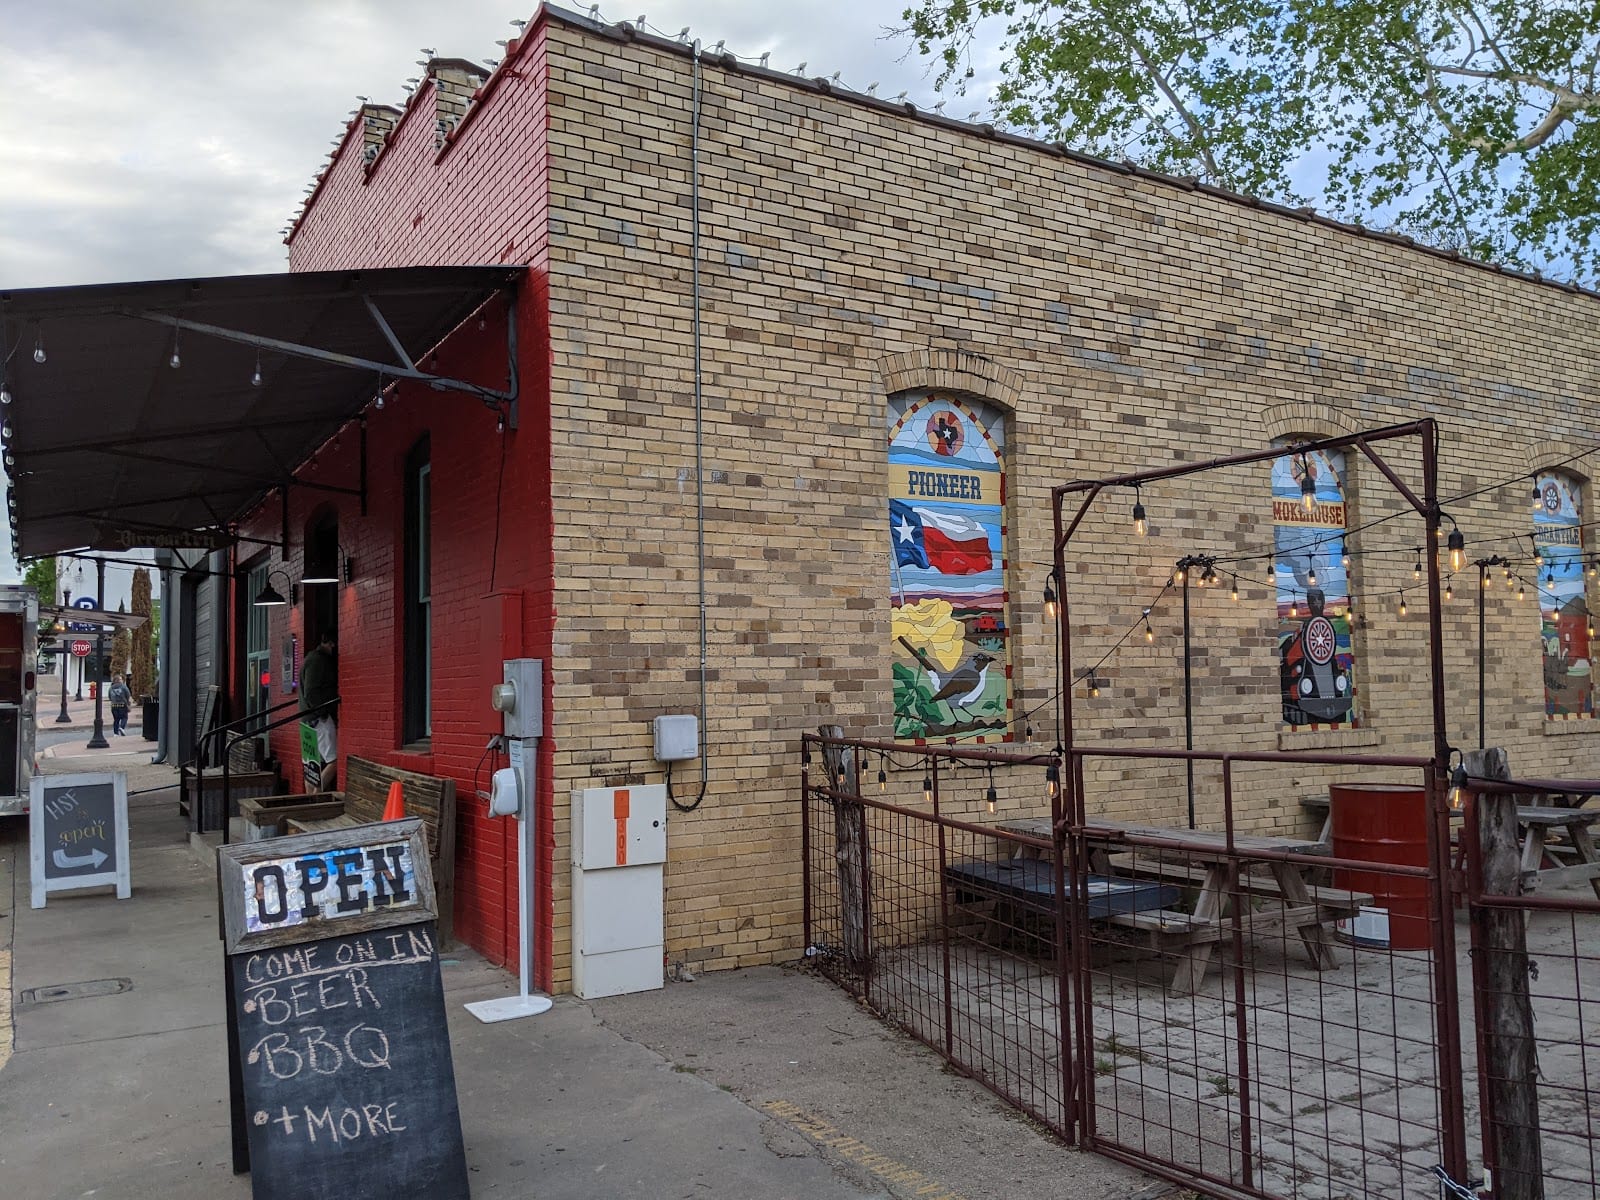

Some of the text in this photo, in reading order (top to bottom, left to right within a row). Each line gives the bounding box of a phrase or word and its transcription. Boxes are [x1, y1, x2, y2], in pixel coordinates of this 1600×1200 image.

[908, 470, 982, 500] PIONEER
[73, 644, 90, 652] STOP
[45, 788, 80, 820] HSF
[60, 824, 105, 844] open
[252, 845, 410, 924] OPEN
[246, 928, 434, 985] COME ON IN
[255, 967, 382, 1026] BEER
[255, 1022, 392, 1080] BBQ
